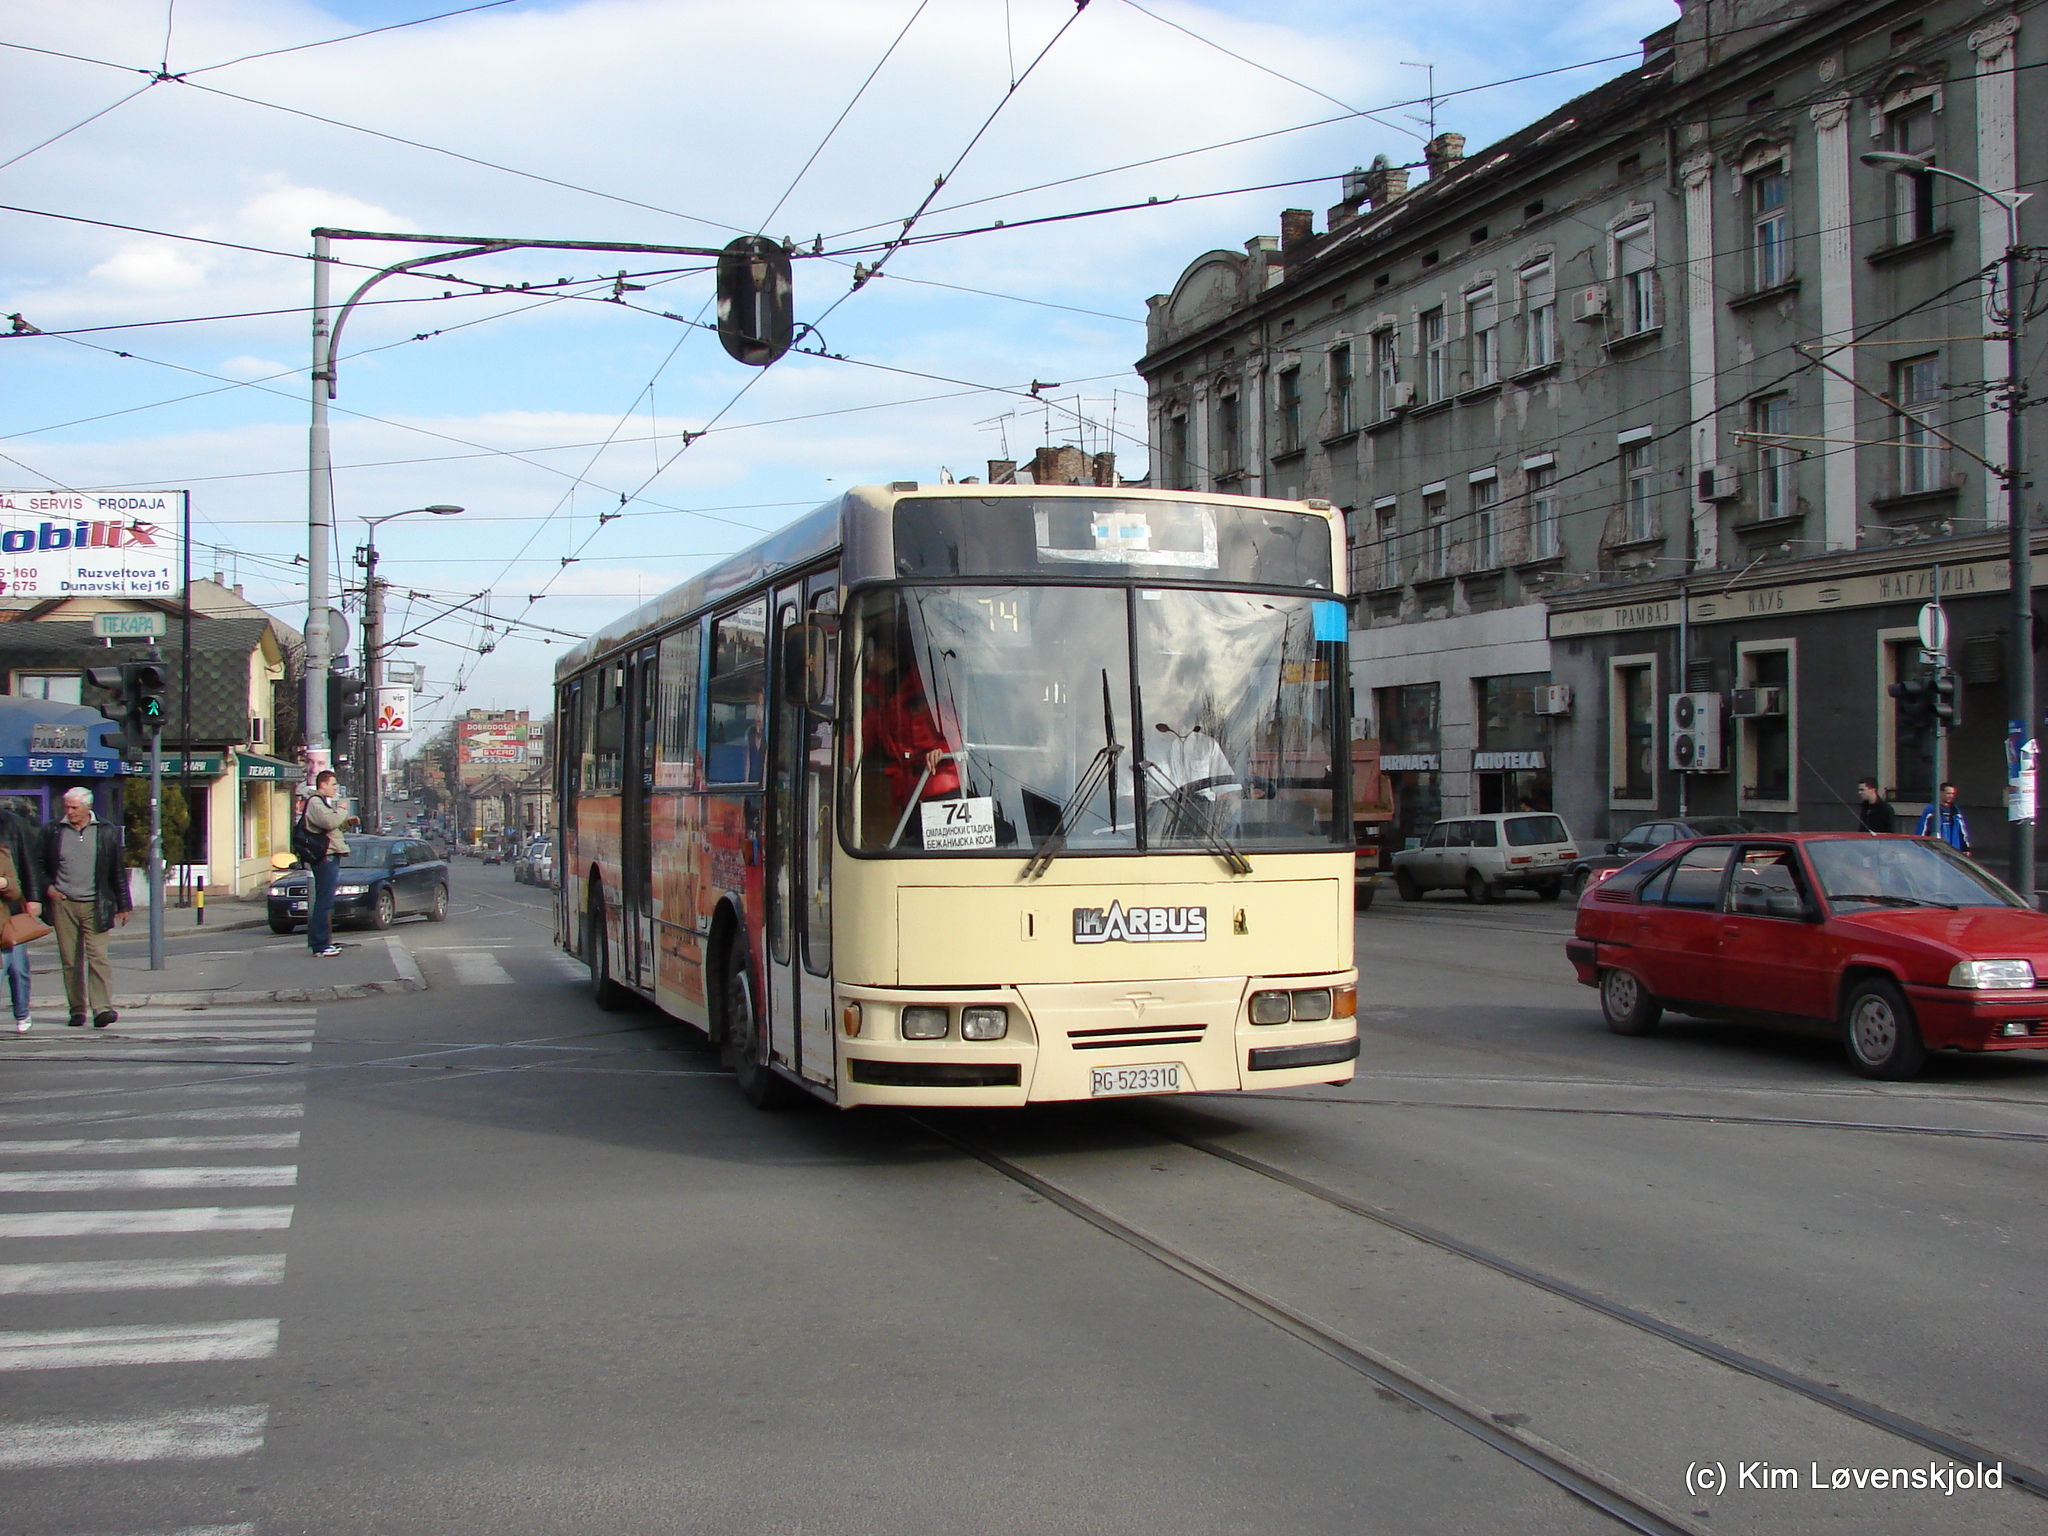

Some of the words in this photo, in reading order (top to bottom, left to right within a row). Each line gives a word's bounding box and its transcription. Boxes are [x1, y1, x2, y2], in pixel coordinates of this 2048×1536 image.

[30, 498, 83, 510] SERVIS
[99, 498, 166, 510] PRODAJA
[78, 568, 156, 578] Ruzveltova
[162, 568, 168, 578] 1
[61, 581, 125, 591] Dunavski
[131, 580, 152, 593] kej
[156, 581, 170, 591] 16
[1615, 603, 1669, 627] ТРАМВАЈ
[1748, 590, 1783, 613] КЛУБ
[978, 599, 1018, 632] 74
[102, 616, 154, 633] ПЕКАРА
[393, 694, 405, 702] vip
[33, 737, 86, 749] FANTASIA
[29, 758, 53, 768] EFES
[67, 759, 85, 769] EFES
[94, 760, 109, 770] EFES
[1474, 751, 1546, 770] АПОТЕКА
[249, 765, 276, 777] ПЕКАРА
[942, 802, 973, 825] 74
[926, 826, 966, 838] ОМЛАДИНСКИ
[966, 823, 993, 835] СТАДИОН
[926, 836, 975, 849] БЕЖАНИЈСКА
[975, 835, 994, 846] КОСА
[1074, 901, 1206, 942] IKARBUS
